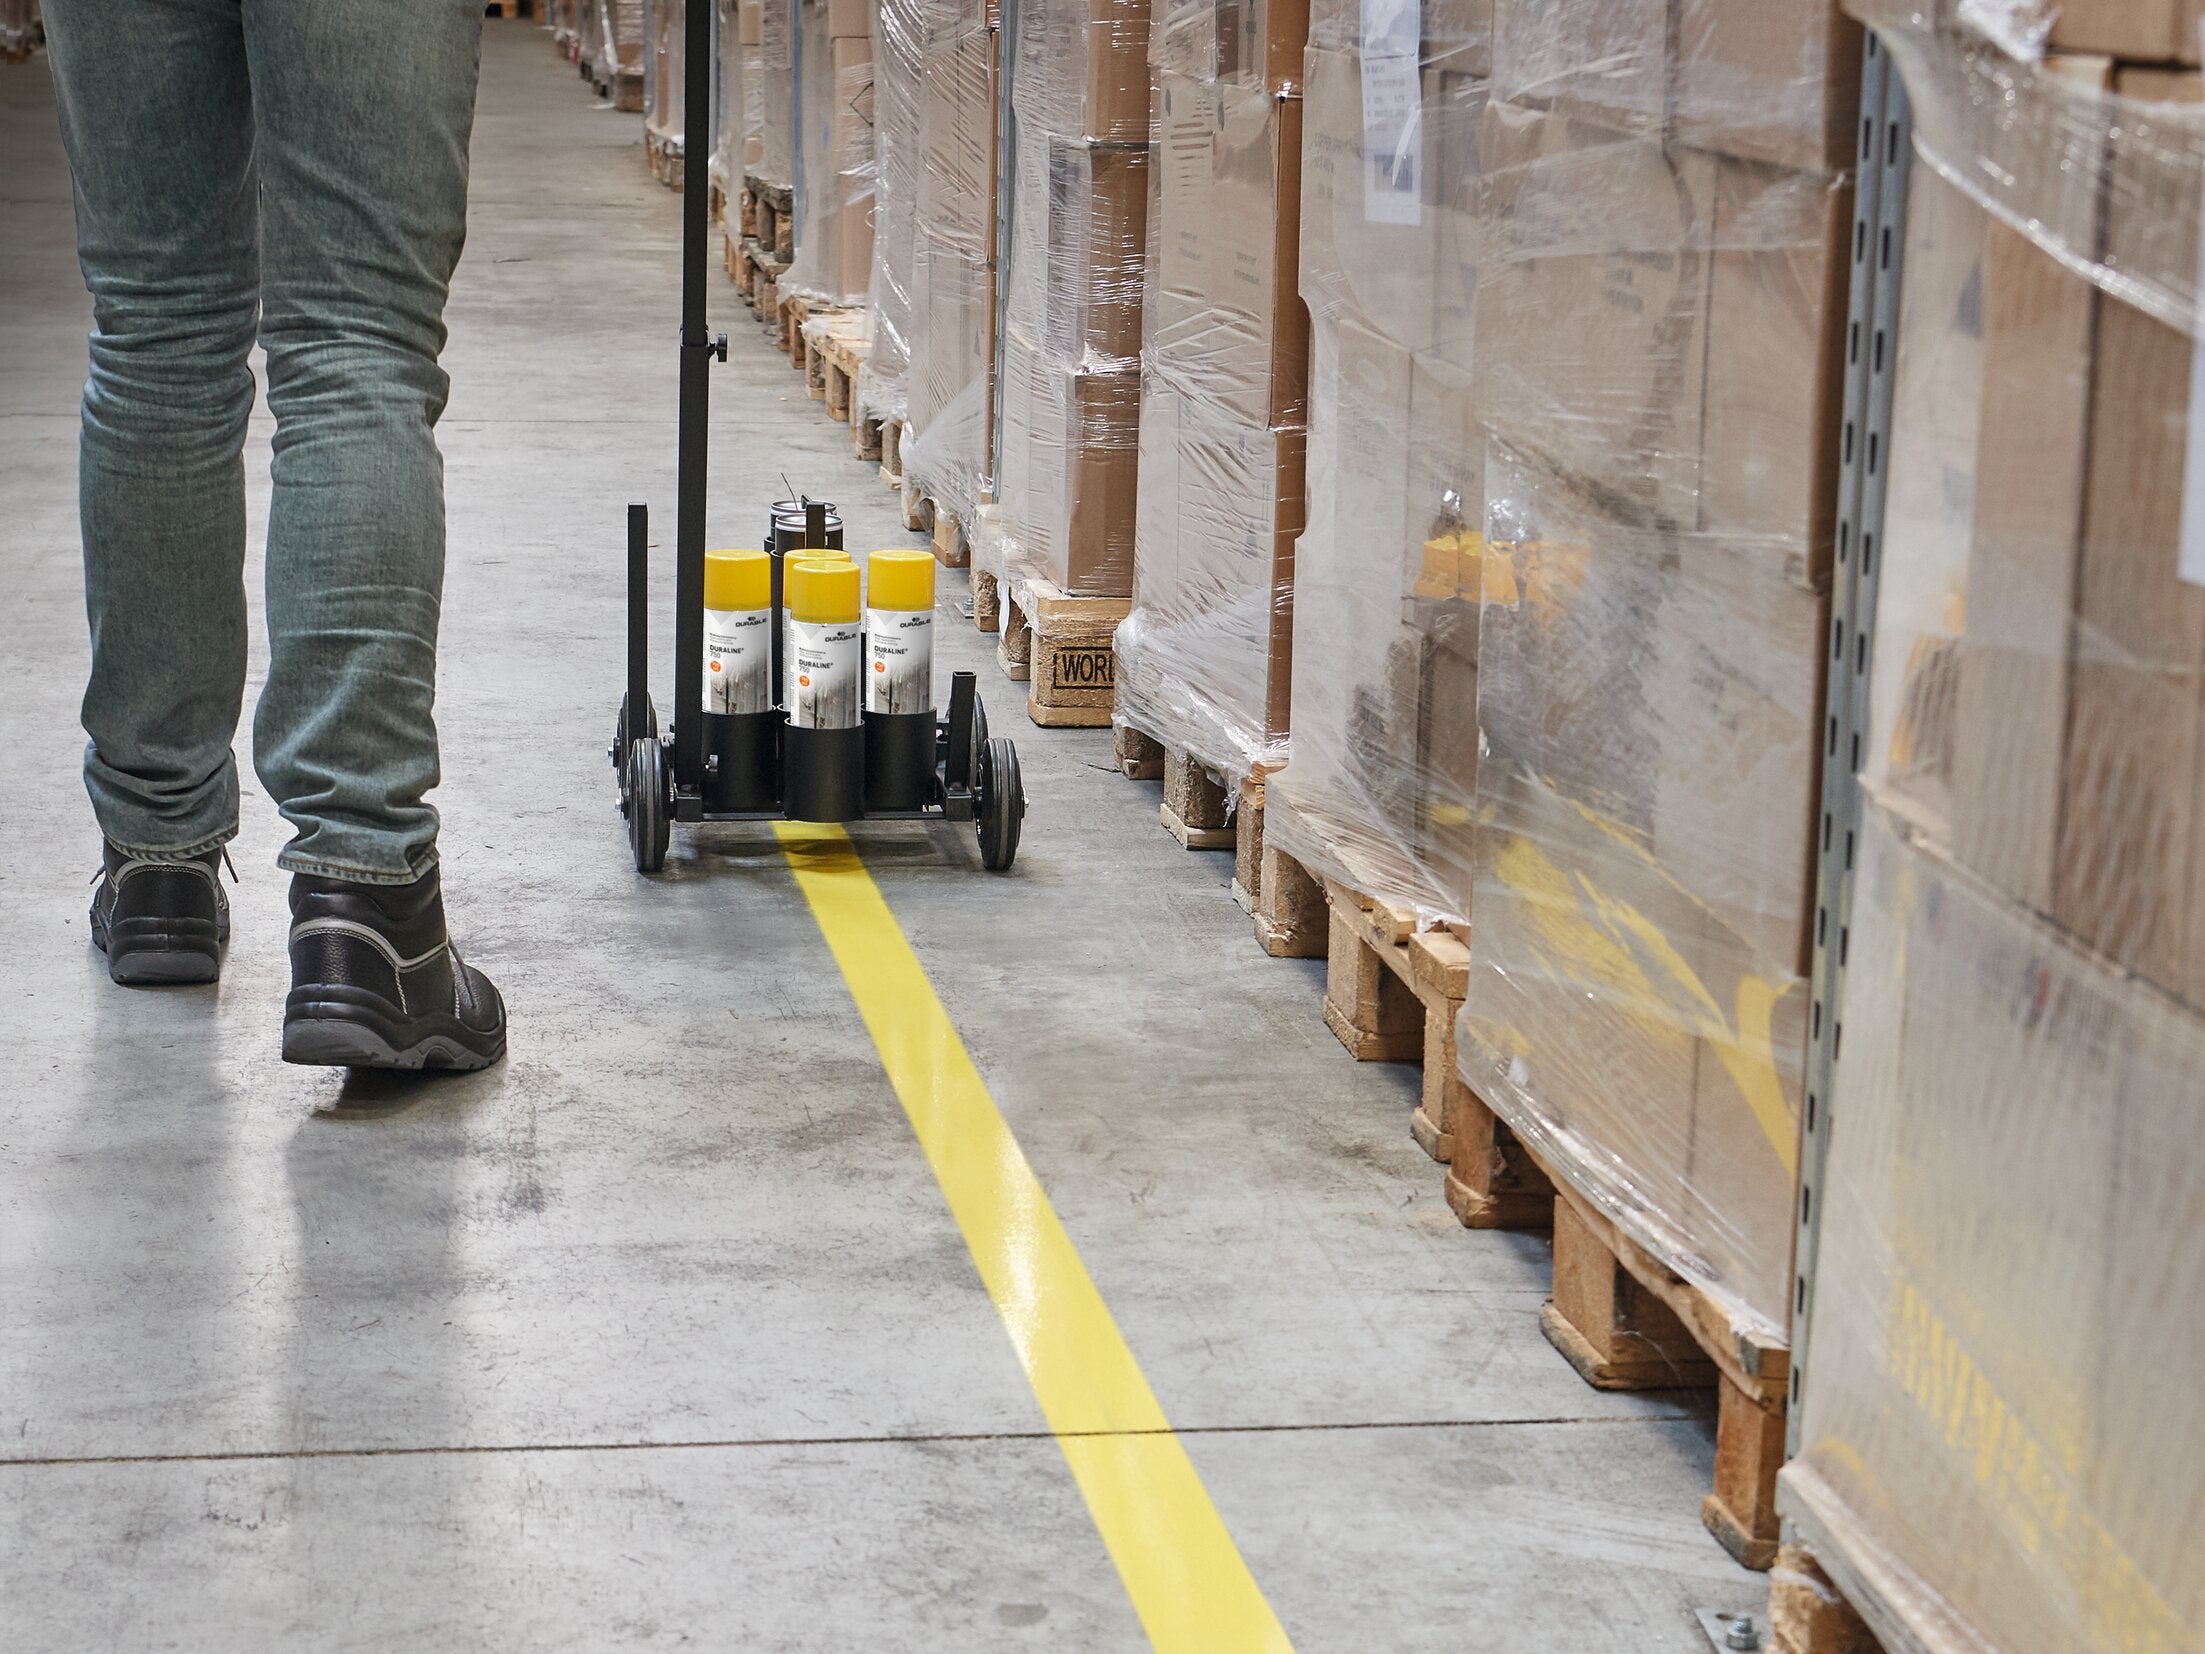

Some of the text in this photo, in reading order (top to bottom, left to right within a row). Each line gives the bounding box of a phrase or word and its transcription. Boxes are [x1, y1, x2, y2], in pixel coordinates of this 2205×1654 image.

[735, 617, 768, 628] DURABLE
[900, 618, 931, 629] DURABLE
[824, 632, 857, 643] DURABLE
